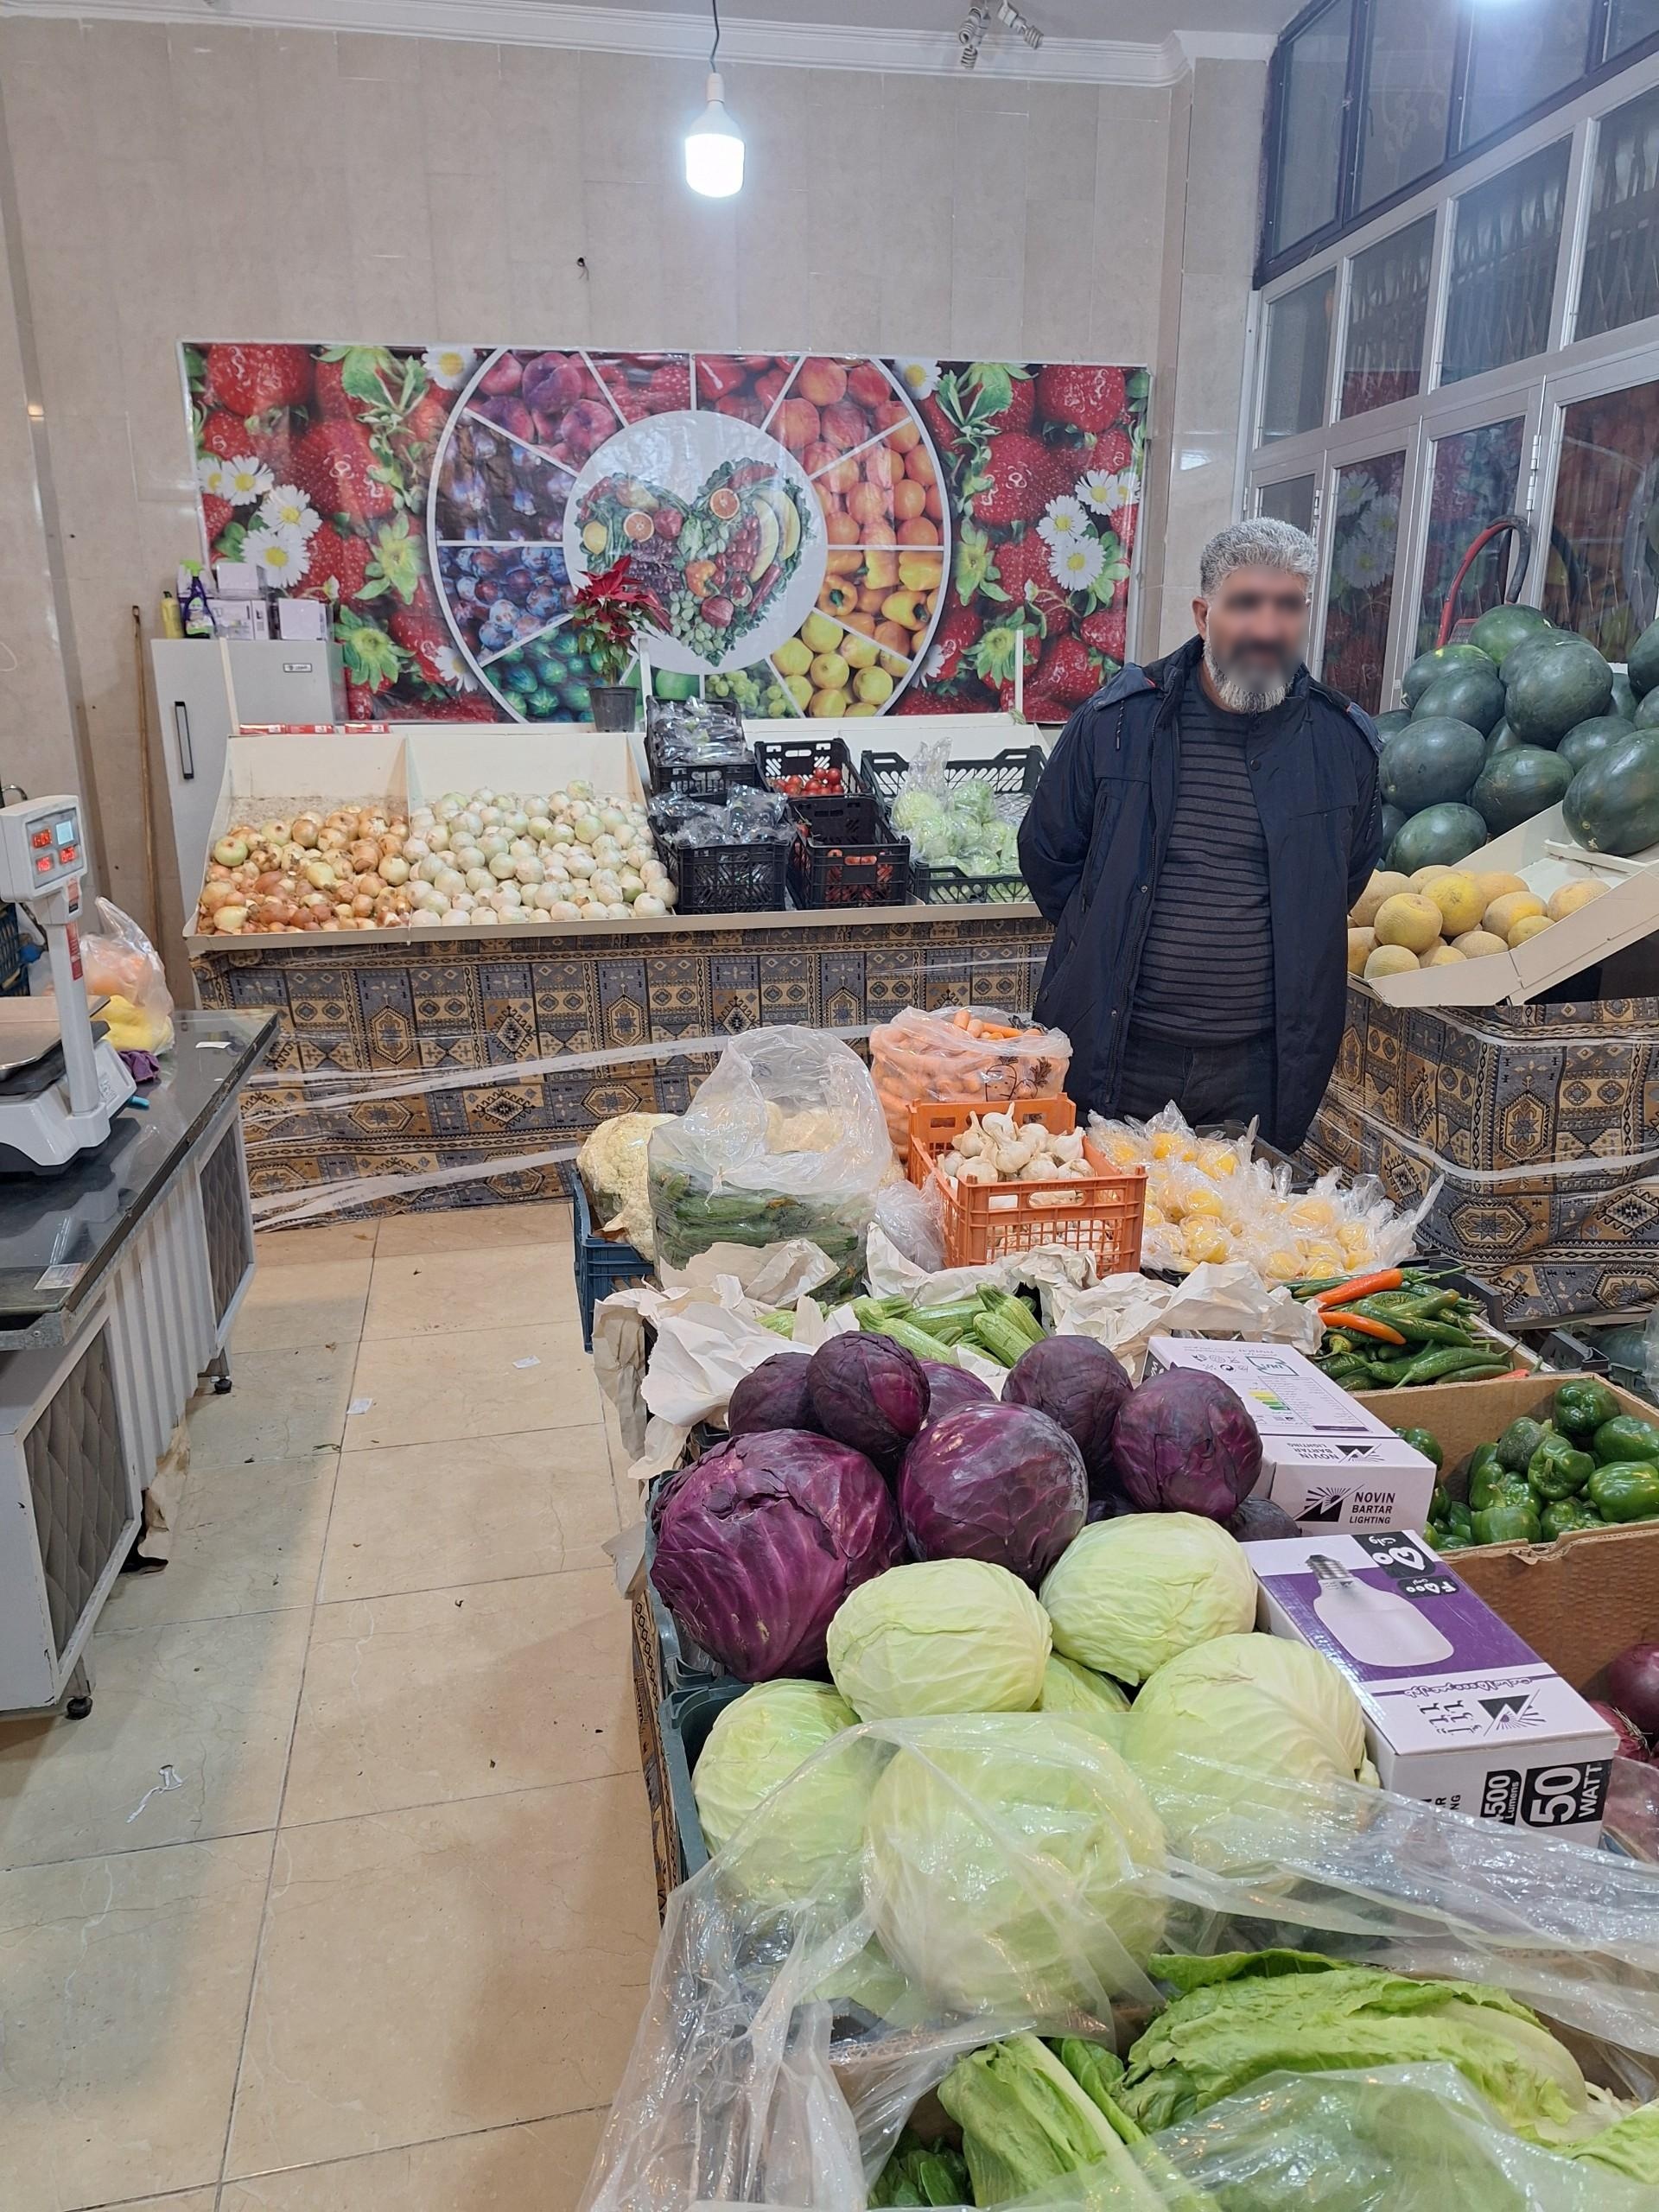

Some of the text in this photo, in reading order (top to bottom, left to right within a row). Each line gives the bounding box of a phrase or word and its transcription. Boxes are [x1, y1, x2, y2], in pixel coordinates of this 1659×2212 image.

[1354, 1492, 1395, 1503] NOVIN
[1352, 1504, 1393, 1514] BARTAR
[1349, 1516, 1390, 1524] LIGHTING
[1368, 1535, 1396, 1547] وات
[1372, 1547, 1426, 1571] ۵۰
[1405, 1581, 1457, 1594] ۴۵۰۰
[1429, 1712, 1473, 1727] نوین
[1529, 1766, 1581, 1823] 50
[1579, 1764, 1603, 1818] WATT
[1504, 1781, 1520, 1819] Lumens
